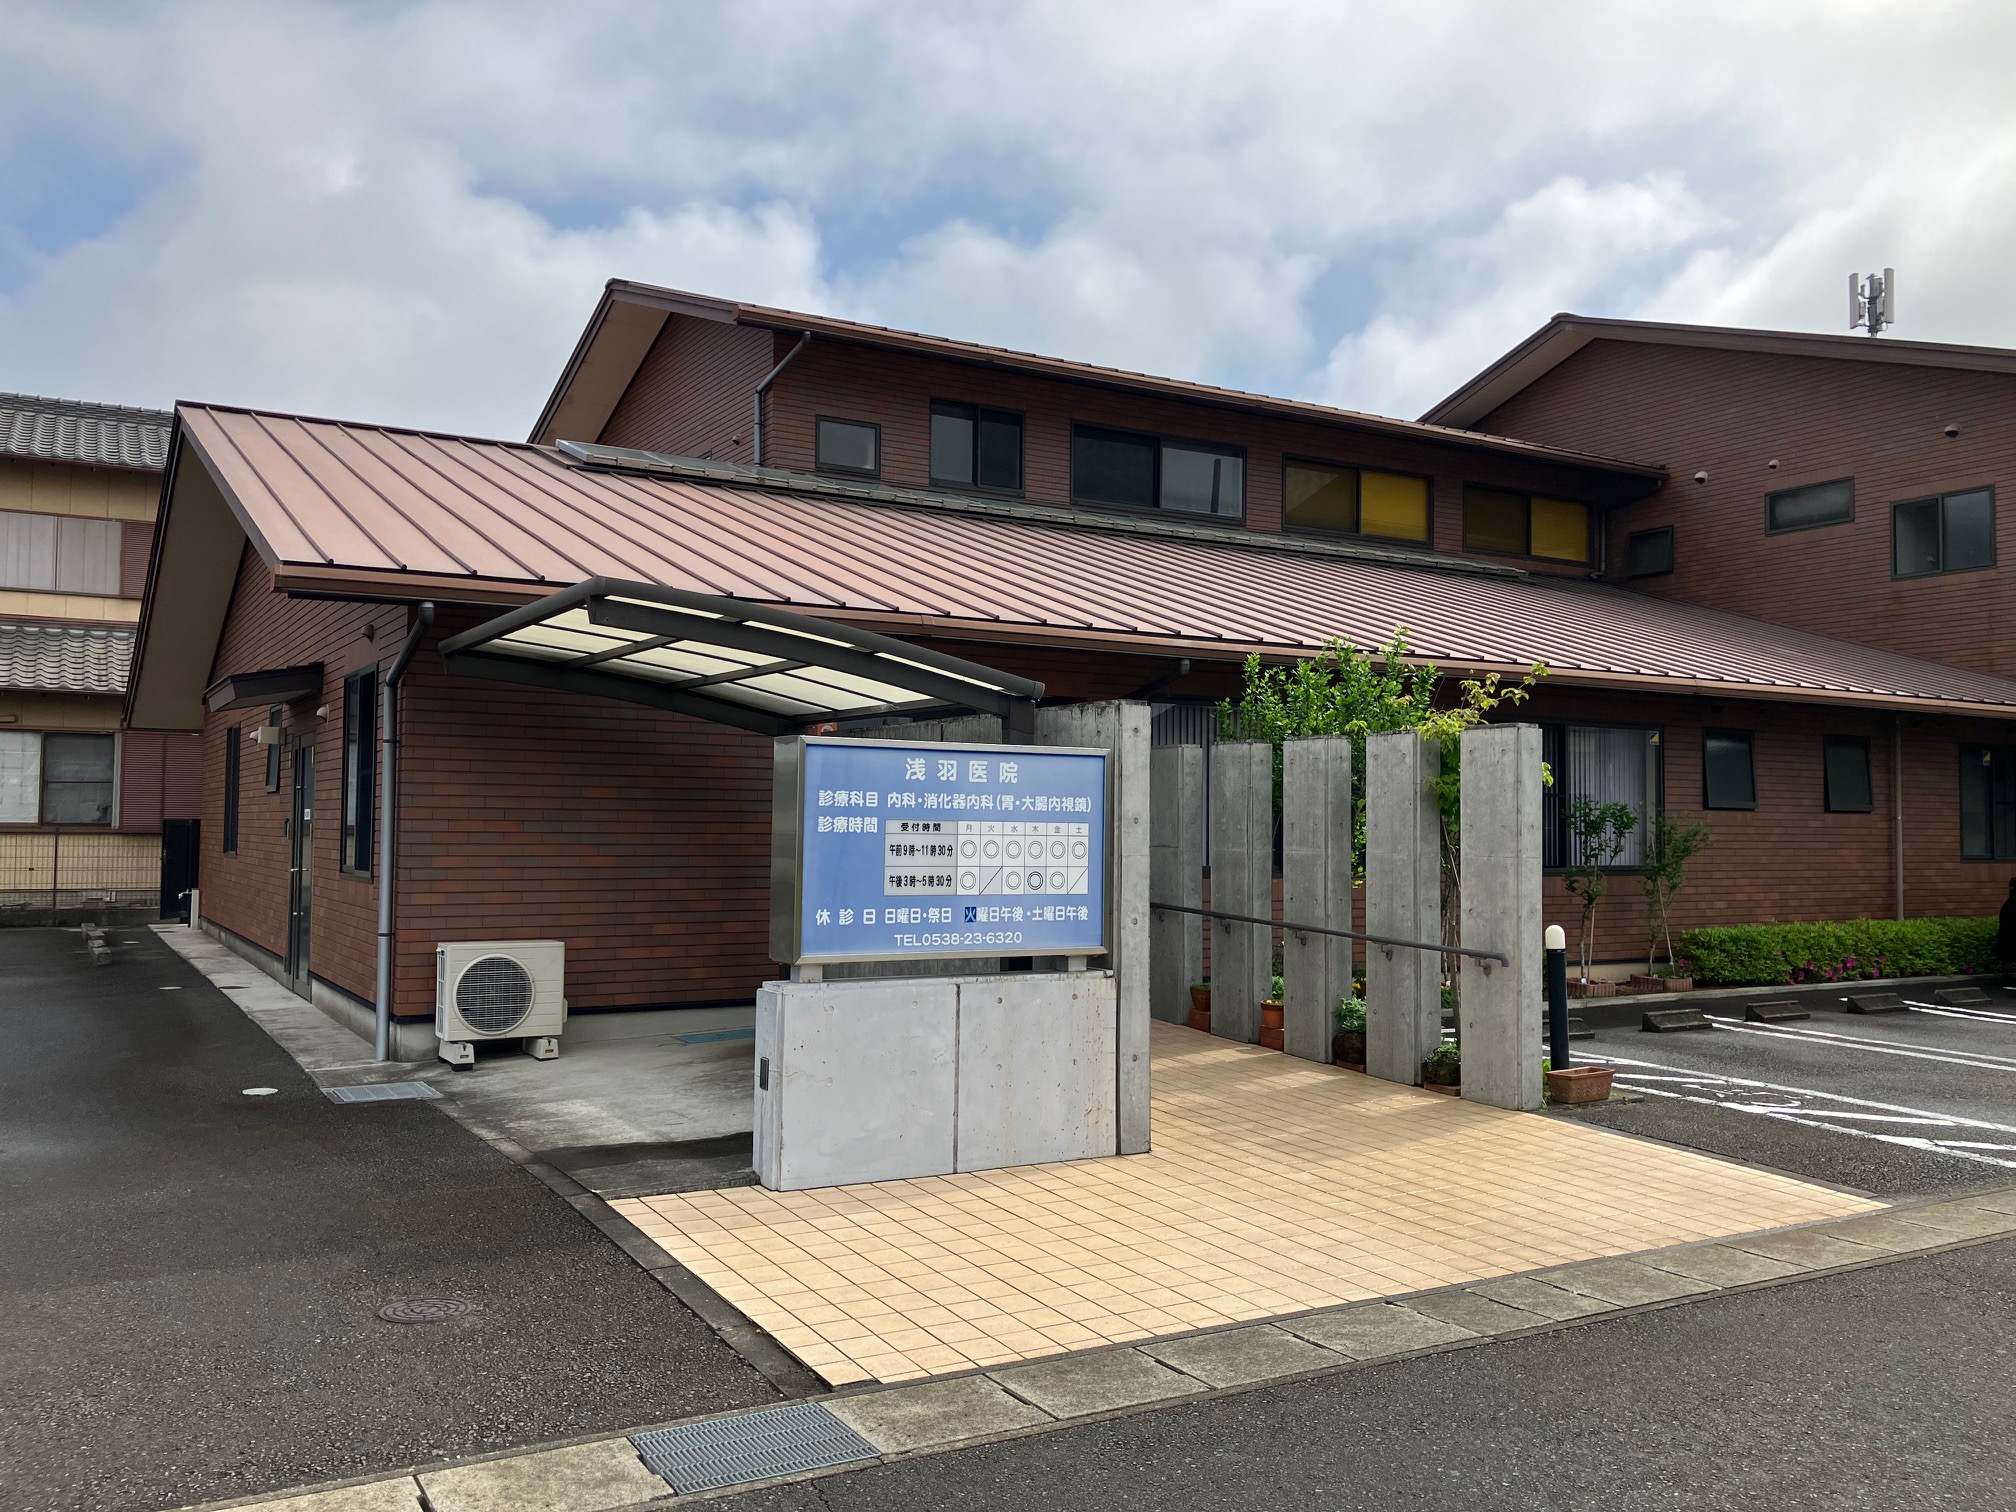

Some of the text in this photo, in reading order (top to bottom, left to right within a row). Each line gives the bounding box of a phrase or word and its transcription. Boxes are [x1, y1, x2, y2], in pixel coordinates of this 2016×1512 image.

[905, 757, 1018, 784] 浅羽医院
[818, 790, 879, 807] 診療科目
[817, 816, 878, 833] 診療時間
[900, 822, 1083, 834] 受付時間 月 火 水 木 金 土
[815, 908, 876, 926] 休診日
